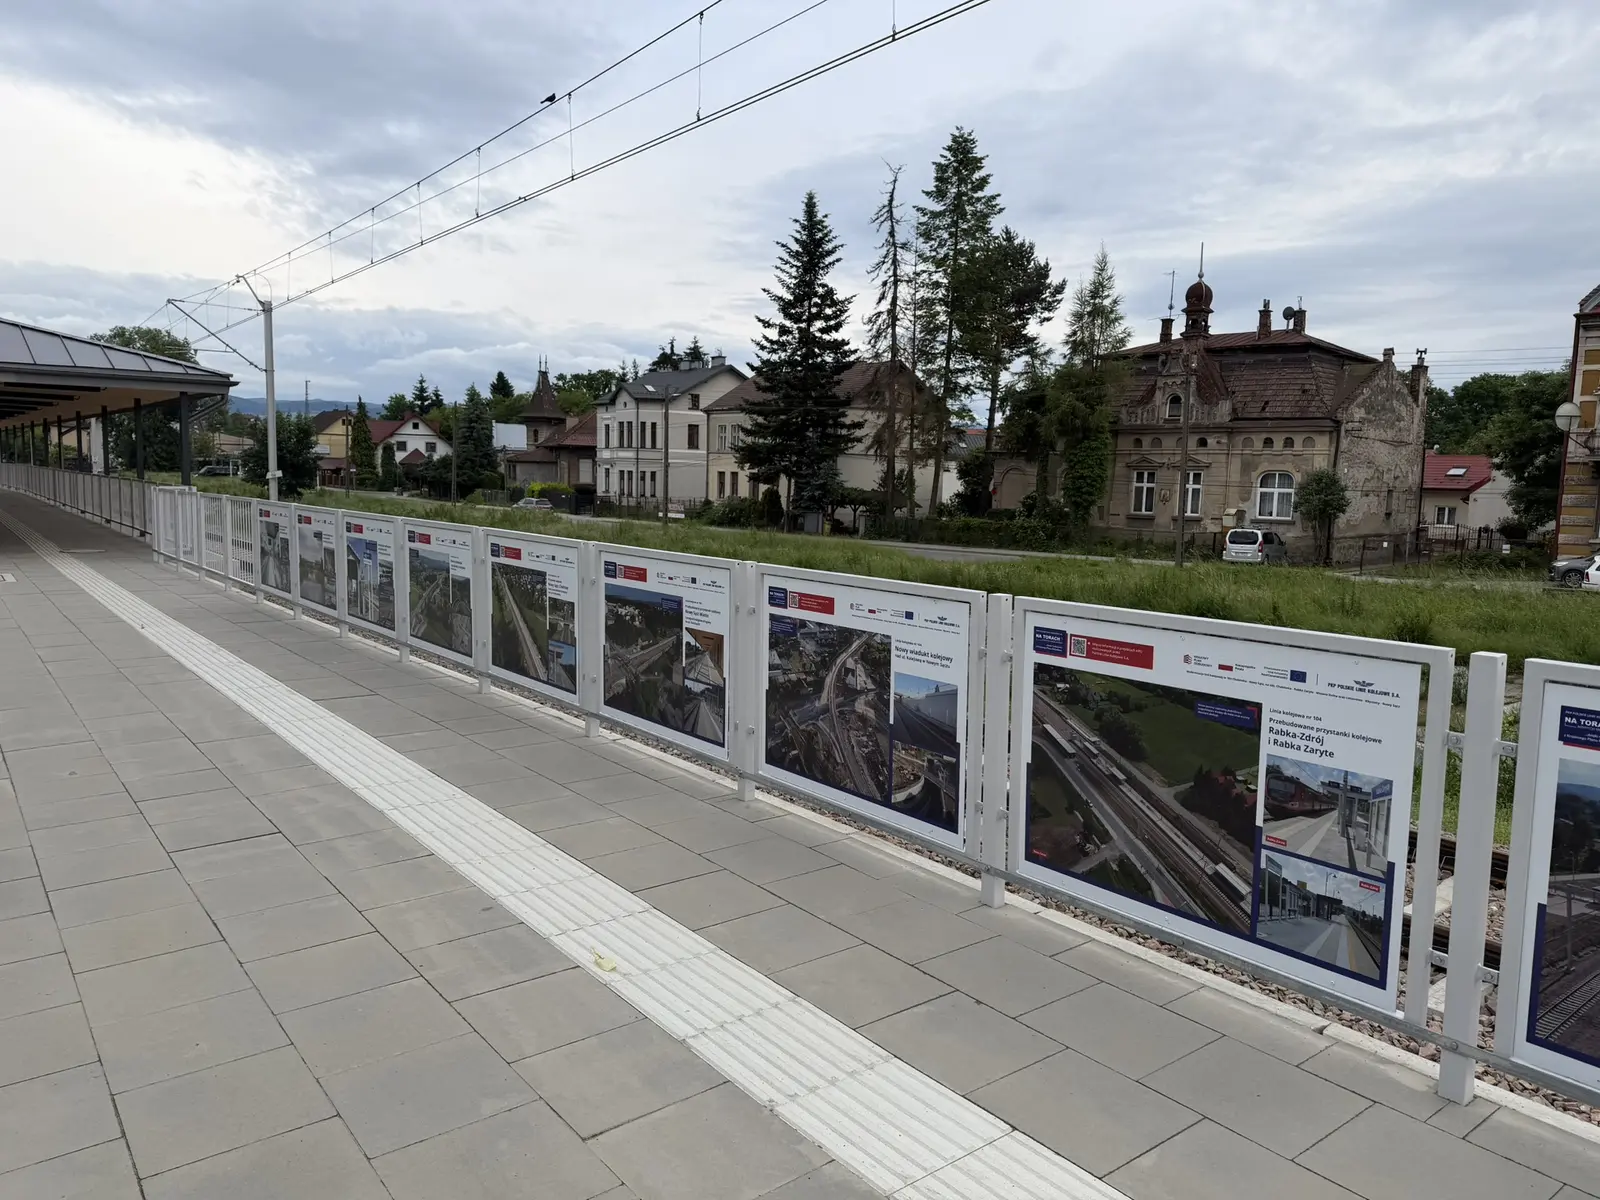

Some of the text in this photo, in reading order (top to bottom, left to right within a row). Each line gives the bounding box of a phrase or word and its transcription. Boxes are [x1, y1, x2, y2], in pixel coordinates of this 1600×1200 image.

[895, 646, 908, 654] Nowy
[1368, 688, 1390, 697] KOLEJOWE
[1282, 709, 1305, 719] kolejowa
[1268, 726, 1324, 746] Rabka-Zdrój
[1269, 717, 1382, 744] Przebudowane przystanki kolejowe
[1273, 738, 1301, 751] Rabka
[1304, 744, 1335, 758] Zaryte
